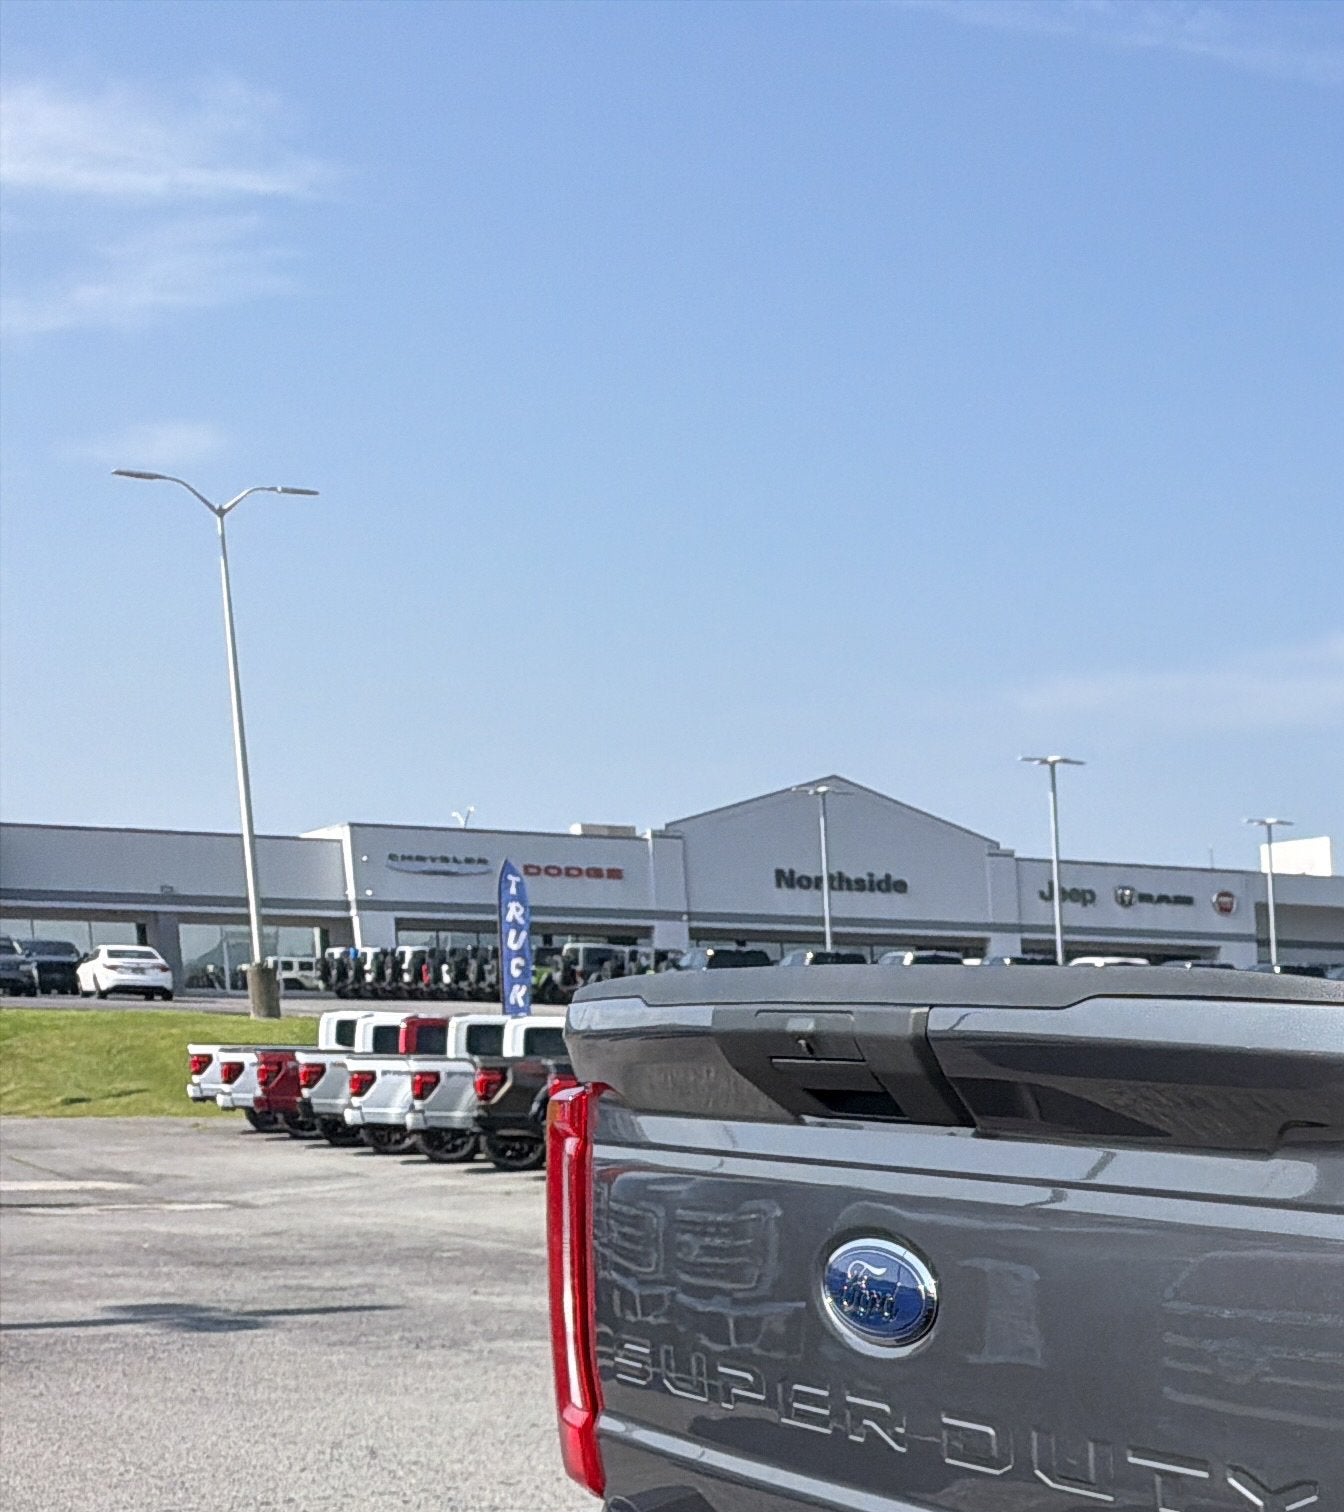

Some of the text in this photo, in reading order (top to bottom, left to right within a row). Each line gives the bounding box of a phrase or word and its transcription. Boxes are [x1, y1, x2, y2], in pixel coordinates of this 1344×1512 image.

[522, 864, 624, 880] DODGE
[775, 868, 908, 893] Northside
[505, 874, 527, 1016] TRUCK
[841, 1260, 901, 1322] Ford
[614, 1335, 906, 1452] SUPER
